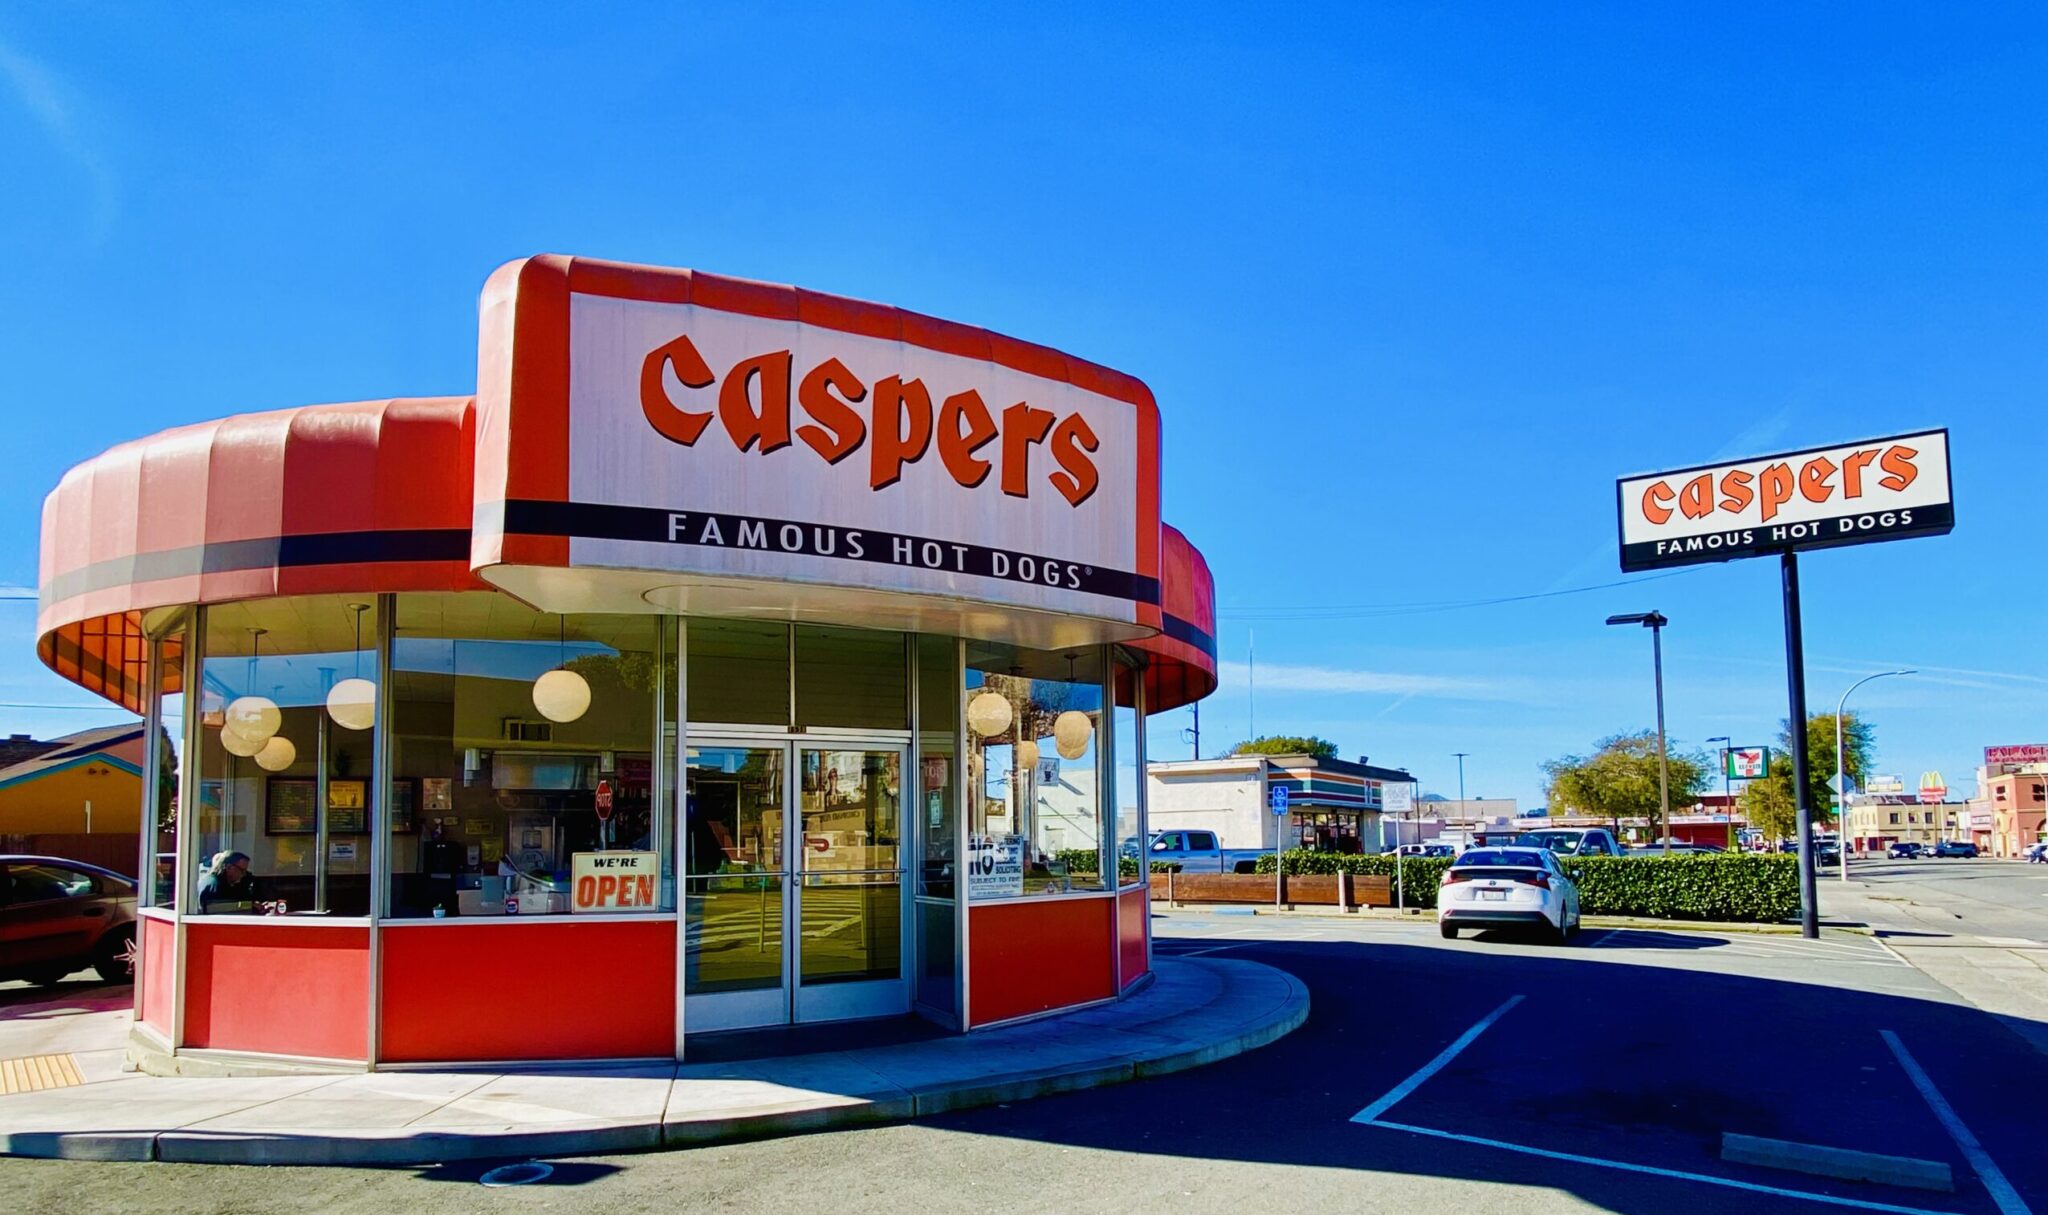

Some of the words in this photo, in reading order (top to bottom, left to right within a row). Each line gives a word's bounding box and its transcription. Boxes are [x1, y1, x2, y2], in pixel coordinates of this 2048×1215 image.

[668, 513, 864, 558] FAMOUS
[893, 537, 968, 572] HOT
[1657, 530, 1754, 556] FAMOUS
[1773, 522, 1821, 541] HOT
[1839, 510, 1913, 533] DOGS
[594, 858, 639, 868] WE'RE
[577, 874, 655, 907] OPEN
